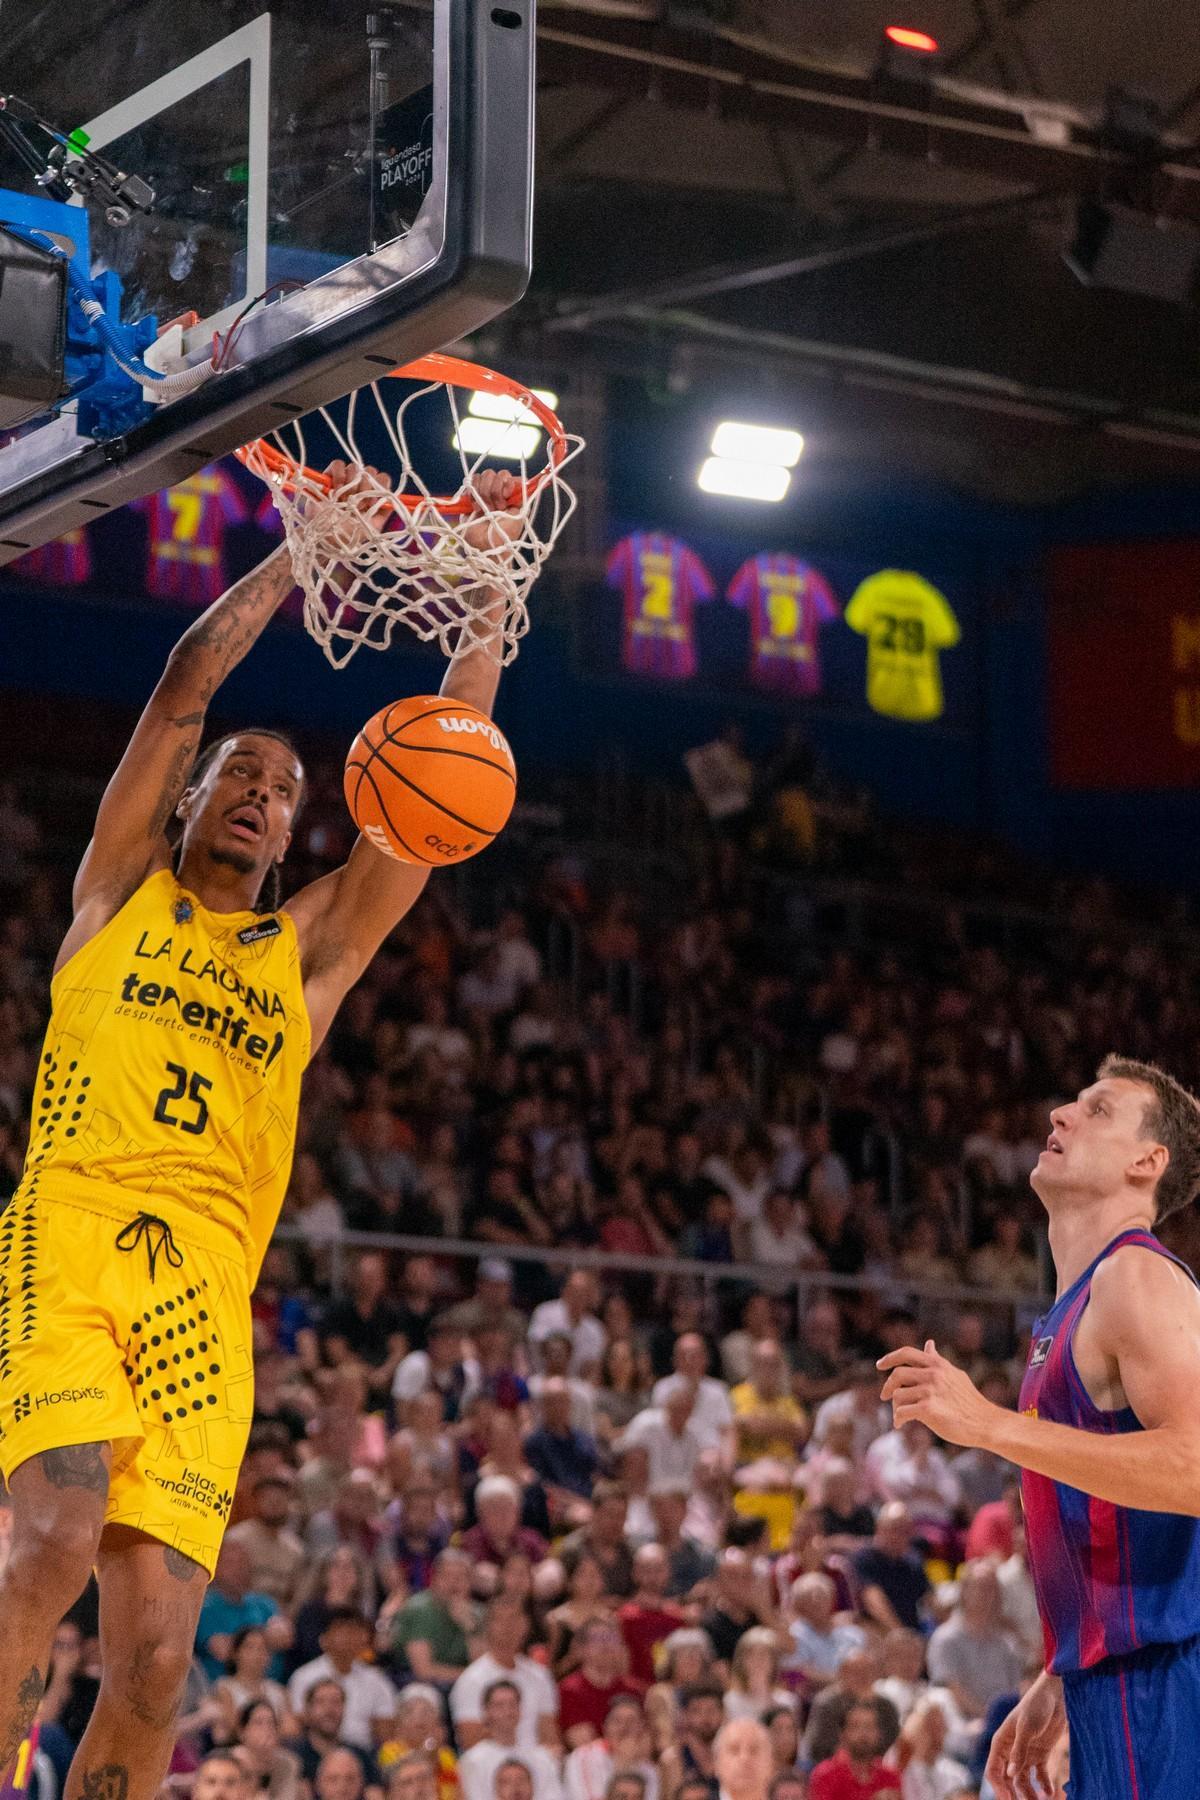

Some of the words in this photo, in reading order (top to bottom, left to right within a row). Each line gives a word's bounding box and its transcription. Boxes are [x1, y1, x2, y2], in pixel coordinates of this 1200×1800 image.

[381, 147, 432, 190] PLAYOFF
[168, 493, 201, 542] 7
[643, 574, 673, 618] 2
[425, 834, 460, 857] acb
[134, 930, 173, 961] LA
[114, 1004, 184, 1032] despierta
[153, 1060, 213, 1135] 25
[181, 1467, 217, 1494] Islas
